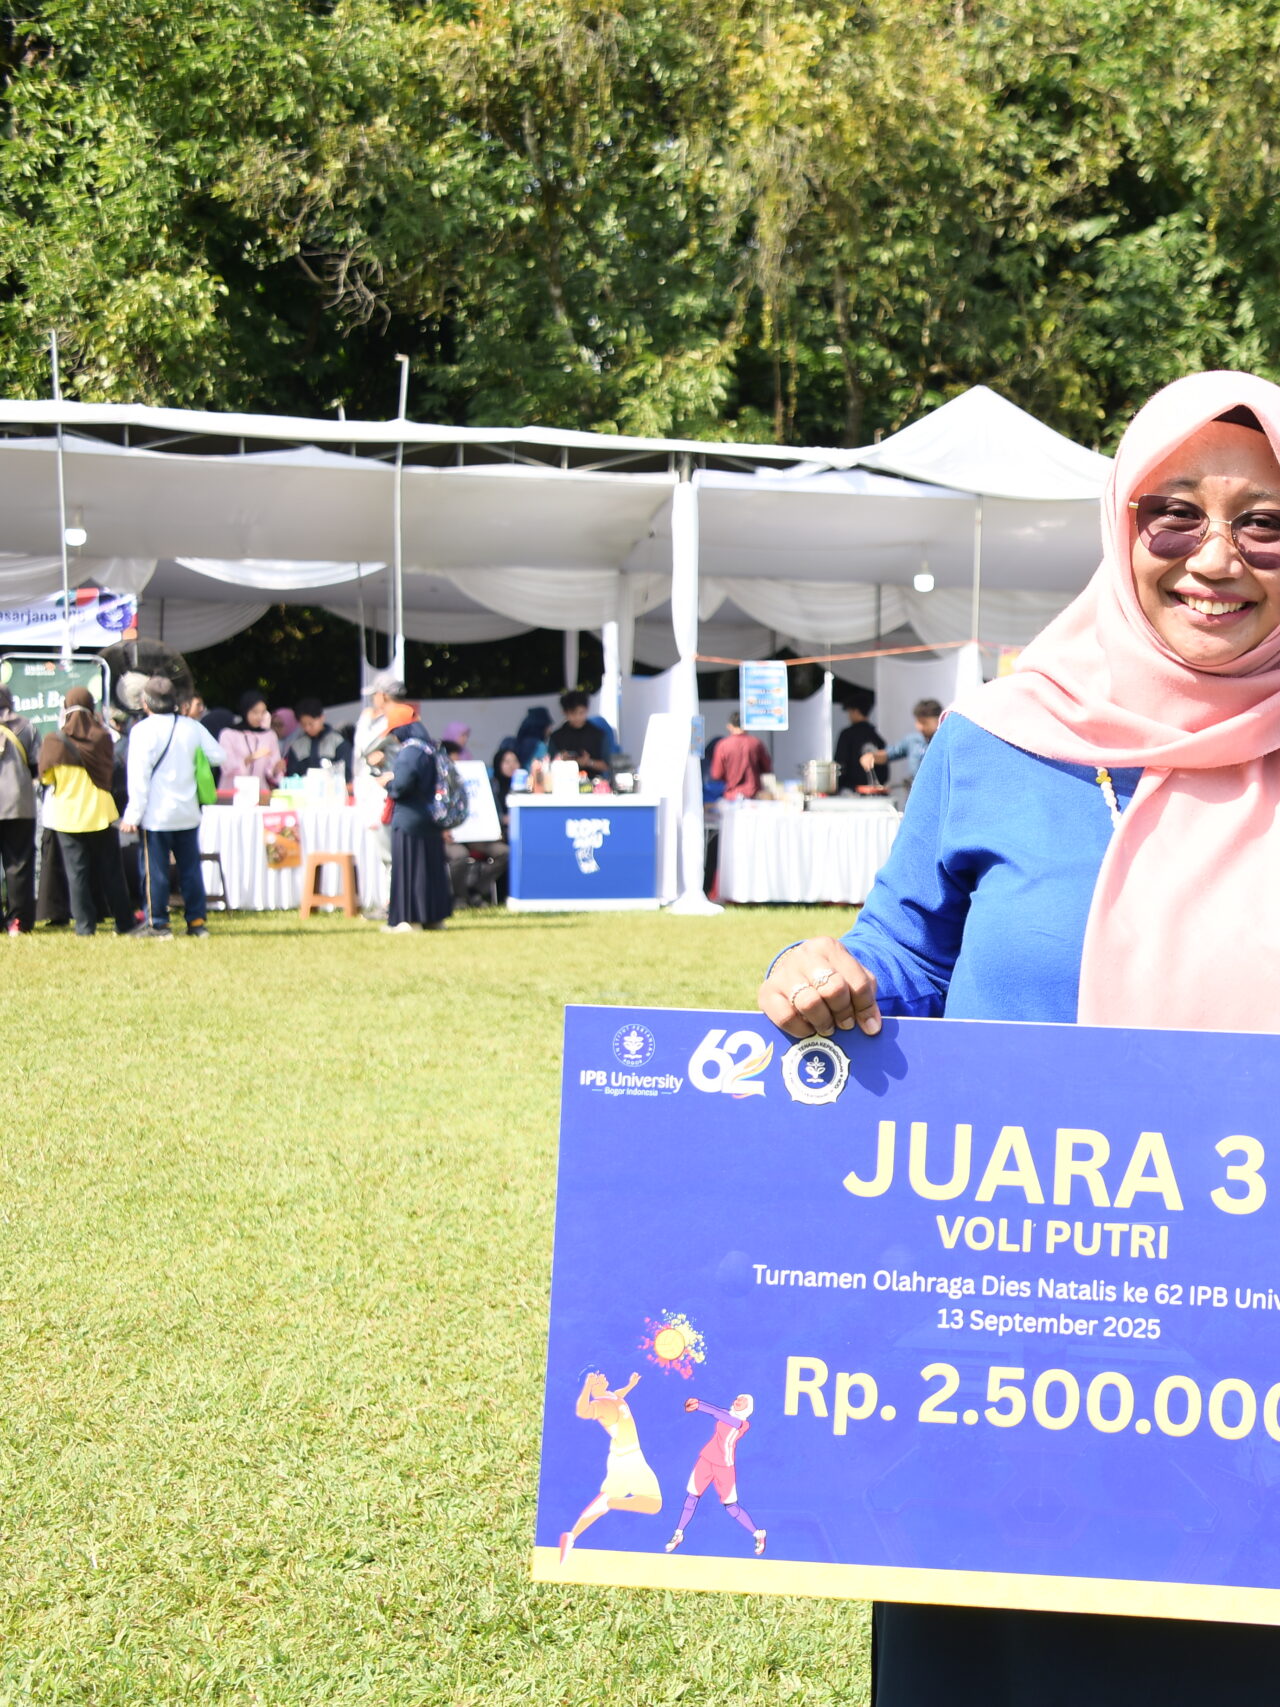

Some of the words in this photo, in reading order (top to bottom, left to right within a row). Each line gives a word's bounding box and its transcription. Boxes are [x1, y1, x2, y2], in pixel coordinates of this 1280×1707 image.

[580, 1070, 608, 1086] IPB
[611, 1071, 683, 1094] University
[688, 1029, 771, 1096] 62
[604, 1086, 625, 1096] Bogor
[626, 1087, 658, 1096] Indonesia
[843, 1120, 1184, 1211] JUARA
[1210, 1135, 1267, 1215] 3
[936, 1215, 1032, 1253] VOLI
[1046, 1220, 1169, 1259] PUTRI
[753, 1264, 867, 1290] Turnamen
[873, 1270, 976, 1299] Olahraga
[982, 1275, 1032, 1298] Dies
[1038, 1278, 1117, 1302] Natalis
[1124, 1281, 1149, 1304] ke
[1155, 1284, 1184, 1306] 62
[1190, 1286, 1229, 1308] IPB
[936, 1308, 964, 1330] 13
[970, 1310, 1098, 1337] September
[1103, 1316, 1161, 1340] 2025
[784, 1356, 897, 1436] Rp.
